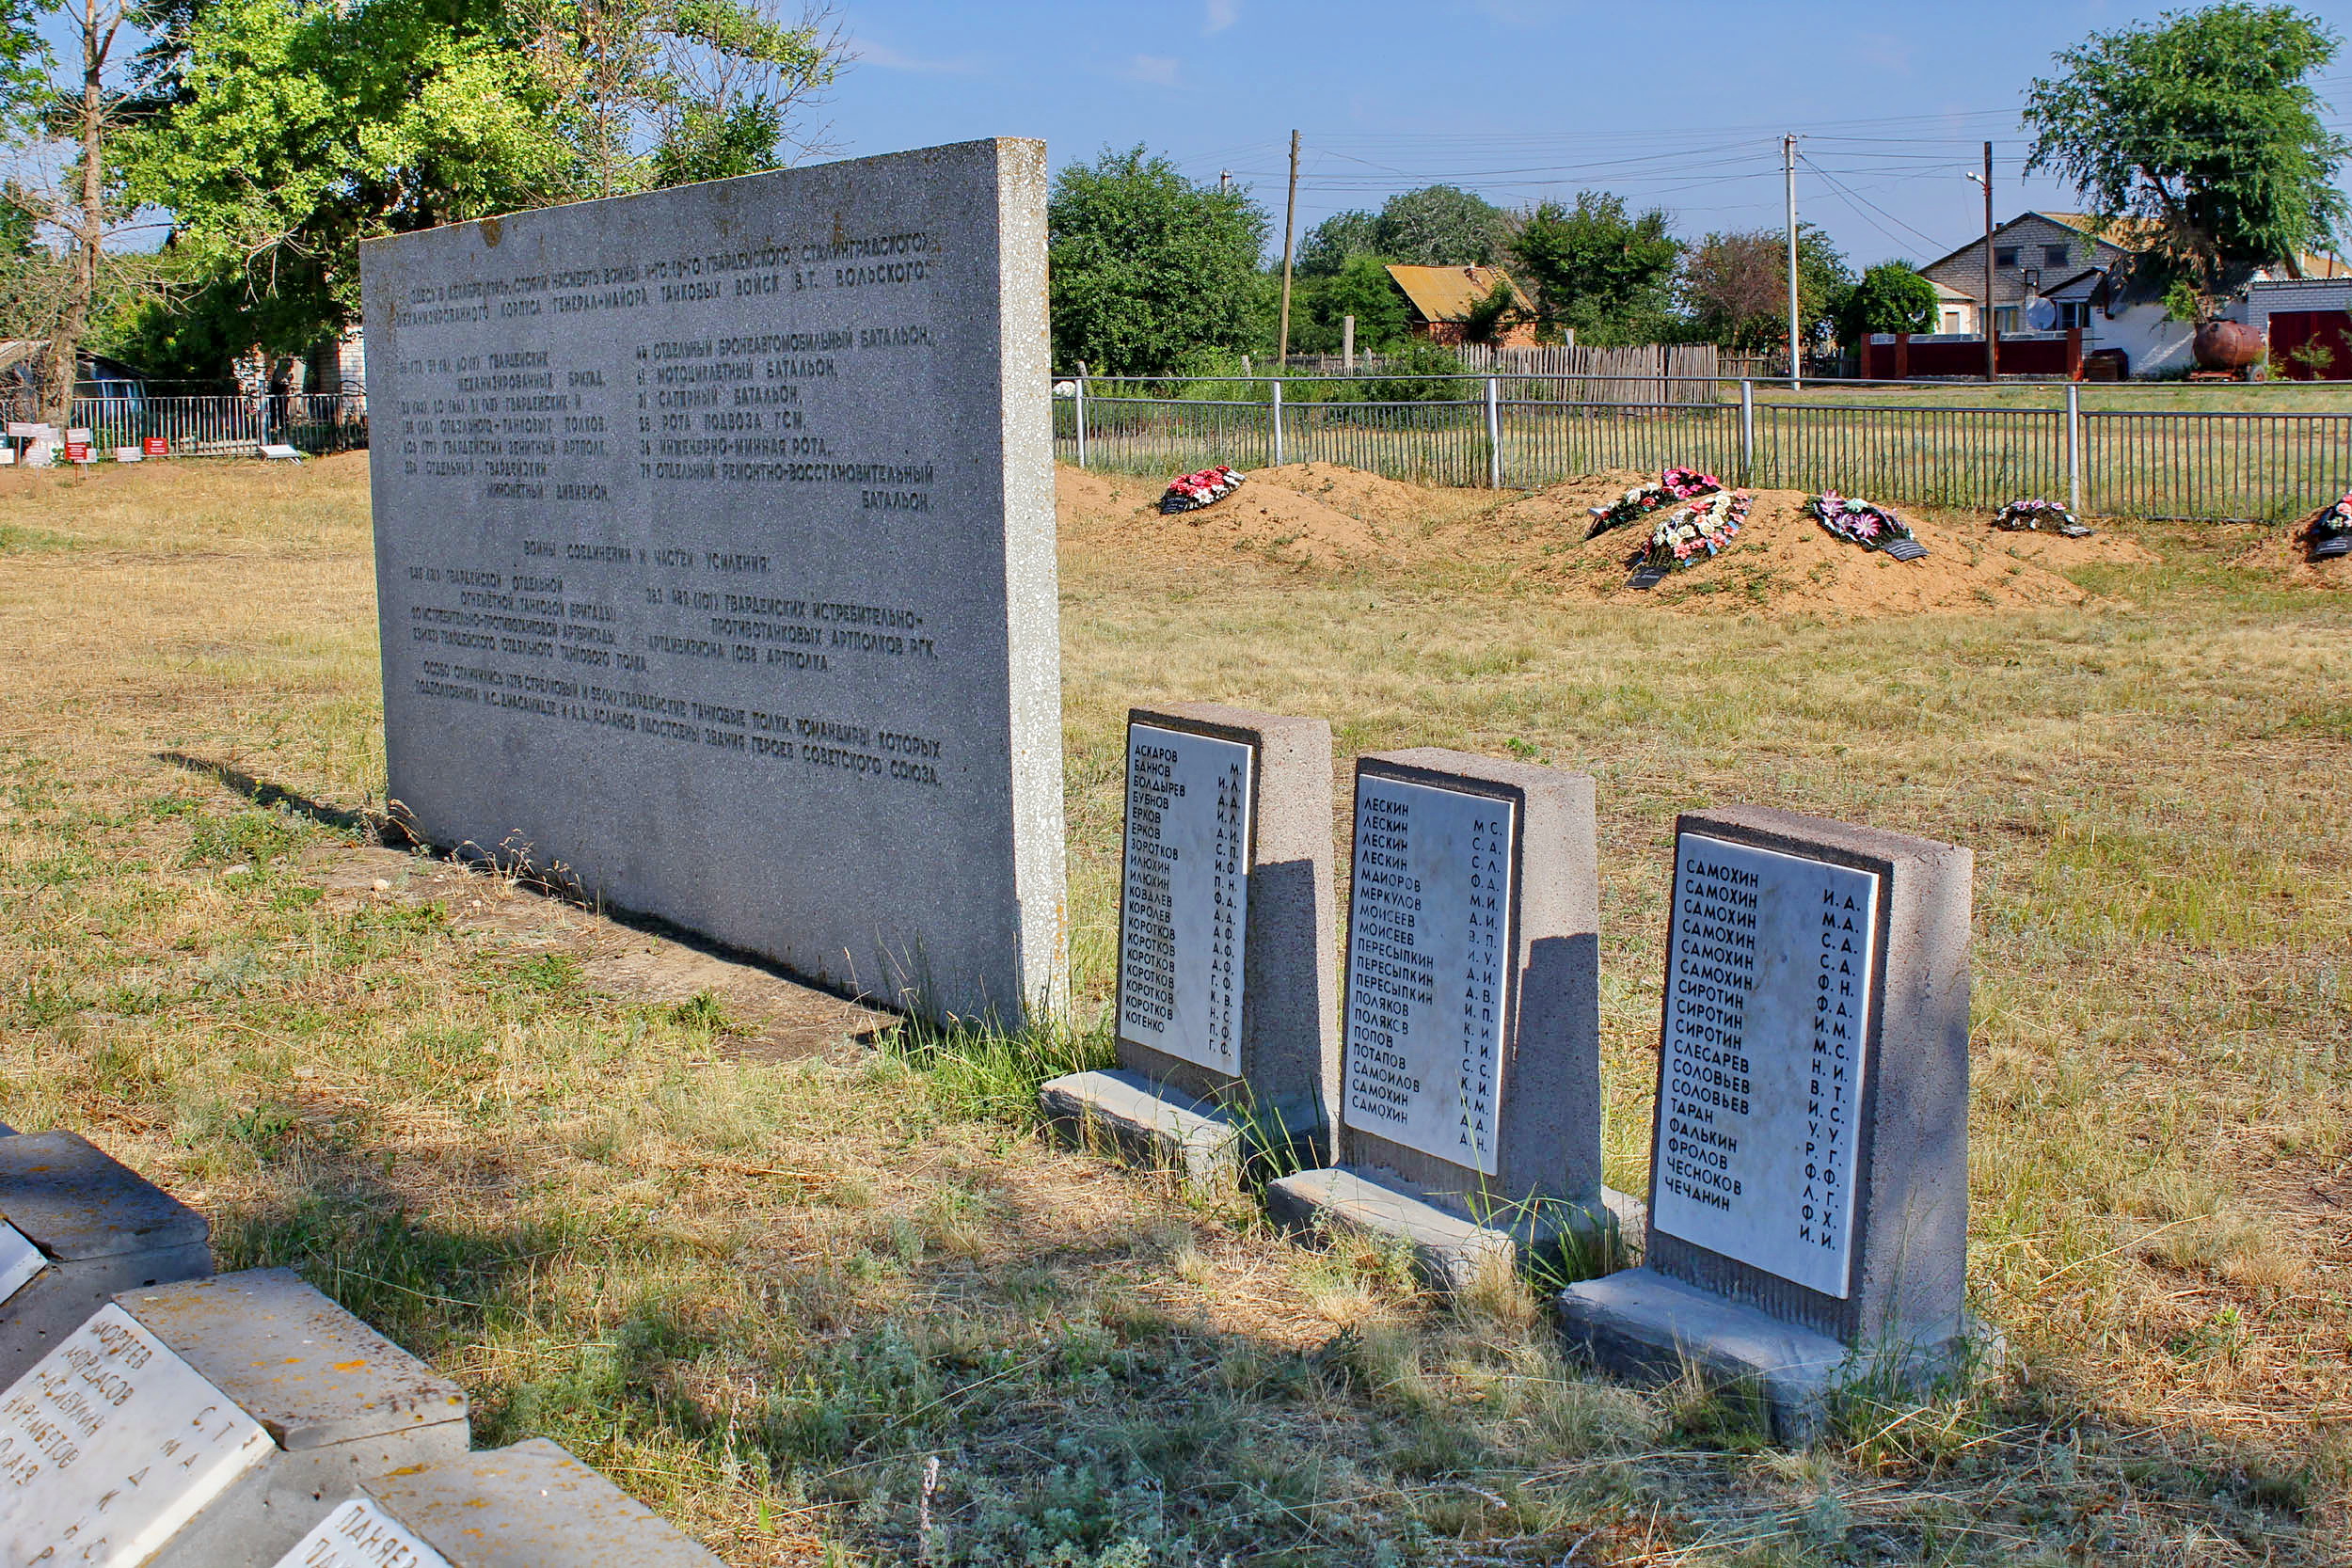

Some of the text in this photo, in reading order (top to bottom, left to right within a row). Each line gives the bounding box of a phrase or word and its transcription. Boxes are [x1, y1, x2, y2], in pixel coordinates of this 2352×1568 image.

[514, 275, 548, 293] СТОЯЛИ
[552, 268, 599, 290] НАСМЕРТЬ
[395, 305, 488, 328] МЕХАНИЗИРОВАННОГО
[501, 298, 541, 319] КОРПУСА
[552, 284, 648, 314] ГЕНЕРАЛ-МАЙОРА
[660, 280, 721, 304] ТАНКОВЫХ
[735, 270, 780, 296] ВОЙСК
[653, 334, 713, 360] ОТДЕЛЬНЫЙ
[718, 325, 853, 356] БРОНЕАВТОМОБИЛЬНЫЙ
[457, 372, 552, 392] МЕХАНИЗИРОВАННЫХ
[657, 357, 754, 384] МОТОЦИКЛЕТНЫЙ
[505, 390, 568, 412] ГВАРДЕЙСКИХ
[661, 413, 691, 431] РОТА
[704, 411, 761, 431] ПОДВОЗА
[508, 436, 555, 455] ЗЕНИТНЫЙ
[660, 437, 786, 457] ИНЖЕНЕРНО-МИННАЯ
[425, 458, 473, 476] ОТДЕЛЬНЫЙ
[656, 458, 933, 485] ОТДЕЛЬНЫЙ РЕМОНТНО-ВОССТАНОВИТЕЛЬНЫЙ
[512, 571, 563, 594] ОТДЕЛЬНОЙ
[519, 594, 564, 617] ТАНКОВОЙ
[811, 600, 923, 631] ИСТРЕБИТЕЛЬНО-
[648, 633, 724, 660] АРТДИВИЗИОНА
[711, 616, 822, 648] ПРОТИВОТАНКОВЫХ
[830, 628, 904, 657] АРТПОЛКОВ
[501, 637, 553, 659] ОТДЕЛЬНОГО
[559, 643, 610, 668] ТАНКОВОГО
[423, 659, 450, 678] ОСОБО
[453, 664, 503, 688] ОТЛИЧИЛИСЬ
[524, 671, 578, 699] СТРЕЛКОВЫЙ
[619, 686, 686, 718] ГВАРДЕЙСКИЕ
[691, 701, 745, 728] ТАНКОВЫЕ
[795, 717, 870, 748] КОМАНДИРЫ
[878, 730, 941, 760] КОТОРЫХ
[415, 678, 478, 705] ПОДПОЛКОВНИКИ
[501, 692, 556, 718] ДИАСАМИДЗЕ
[593, 708, 635, 732] АСЛАНОВ
[639, 715, 699, 743] УДОСТОЕНЫ
[705, 727, 744, 752] ЗВАНИЯ
[751, 735, 793, 760] ГЕРОЕВ
[802, 743, 882, 776] СОВЕТСКОГО
[889, 758, 942, 787] СОЮЗА.
[1135, 744, 1178, 764] АСКАРОВ
[1135, 759, 1170, 778] БАННОВ
[1134, 775, 1185, 797] БОЛДЫРЕВ
[1133, 790, 1169, 810] БУБНОВ
[1364, 797, 1408, 816] ЛЕСКИН
[1132, 806, 1161, 824] ЕРКОВ
[1363, 816, 1407, 835] ЛЕСКИН
[1132, 822, 1161, 840] ЕРКОВ
[1362, 832, 1407, 852] ЛЕСКИН
[1131, 837, 1178, 861] ЗОРОТКОВ
[1362, 849, 1407, 871] ЛЕСКИН
[1130, 854, 1169, 875] ИЛЮХИН
[1687, 859, 1758, 888] САМОХИН
[1130, 869, 1169, 892] ИЛЮХИН
[1685, 879, 1757, 909] САМОХИН
[1129, 885, 1172, 908] КОВАЛЕВ
[1360, 886, 1422, 911] МЕРКУЛОВ
[1129, 900, 1171, 924] КОРОЛЕВ
[1359, 904, 1415, 927] МОИСЕЕВ
[1684, 899, 1756, 929] САМОХИН
[1128, 916, 1176, 941] КОРОТКОВ
[1359, 921, 1414, 946] МОИСЕЕВ
[1682, 919, 1756, 950] САМОХИН
[1127, 932, 1175, 957] КОРОТКОВ
[1358, 938, 1434, 970] ПЕРЕСЫПКИН
[1681, 939, 1754, 971] САМОХИН
[1127, 947, 1175, 973] КОРОТКОВ
[1357, 956, 1433, 988] ПЕРЕСЫПКИН
[1680, 958, 1753, 990] САМОХИН
[1126, 978, 1174, 1005] КОРОТКОВ
[1356, 973, 1433, 1006] ПЕРЕСЫПКИН
[1678, 979, 1743, 1010] СИРОТИН
[1125, 994, 1173, 1021] КОРОТКОВ
[1356, 990, 1409, 1017] ПОЛЯКОВ
[1677, 999, 1742, 1030] СИРОТИН
[1125, 1009, 1165, 1034] КОТЕНКО
[1676, 1019, 1741, 1051] СИРОТИН
[1354, 1025, 1393, 1049] ПОПОВ
[1354, 1042, 1406, 1070] ПОТАПОВ
[1674, 1039, 1749, 1074] СЛЕСАРЕВ
[1673, 1058, 1750, 1095] СОЛОВЬЕВ
[1352, 1078, 1408, 1107] САМОХИН
[1672, 1078, 1749, 1116] СОЛОВЬЕВ
[1352, 1095, 1407, 1125] САМОХИН
[1671, 1097, 1713, 1125] ТАРАН
[1669, 1117, 1737, 1153] ФАЛЬКИН
[1668, 1137, 1727, 1170] ФРОЛОВ
[1667, 1156, 1741, 1196] ЧЕСНОКОВ
[1665, 1176, 1730, 1212] ЧЕЧАНИН
[61, 1346, 135, 1407] МОРДАСОВ
